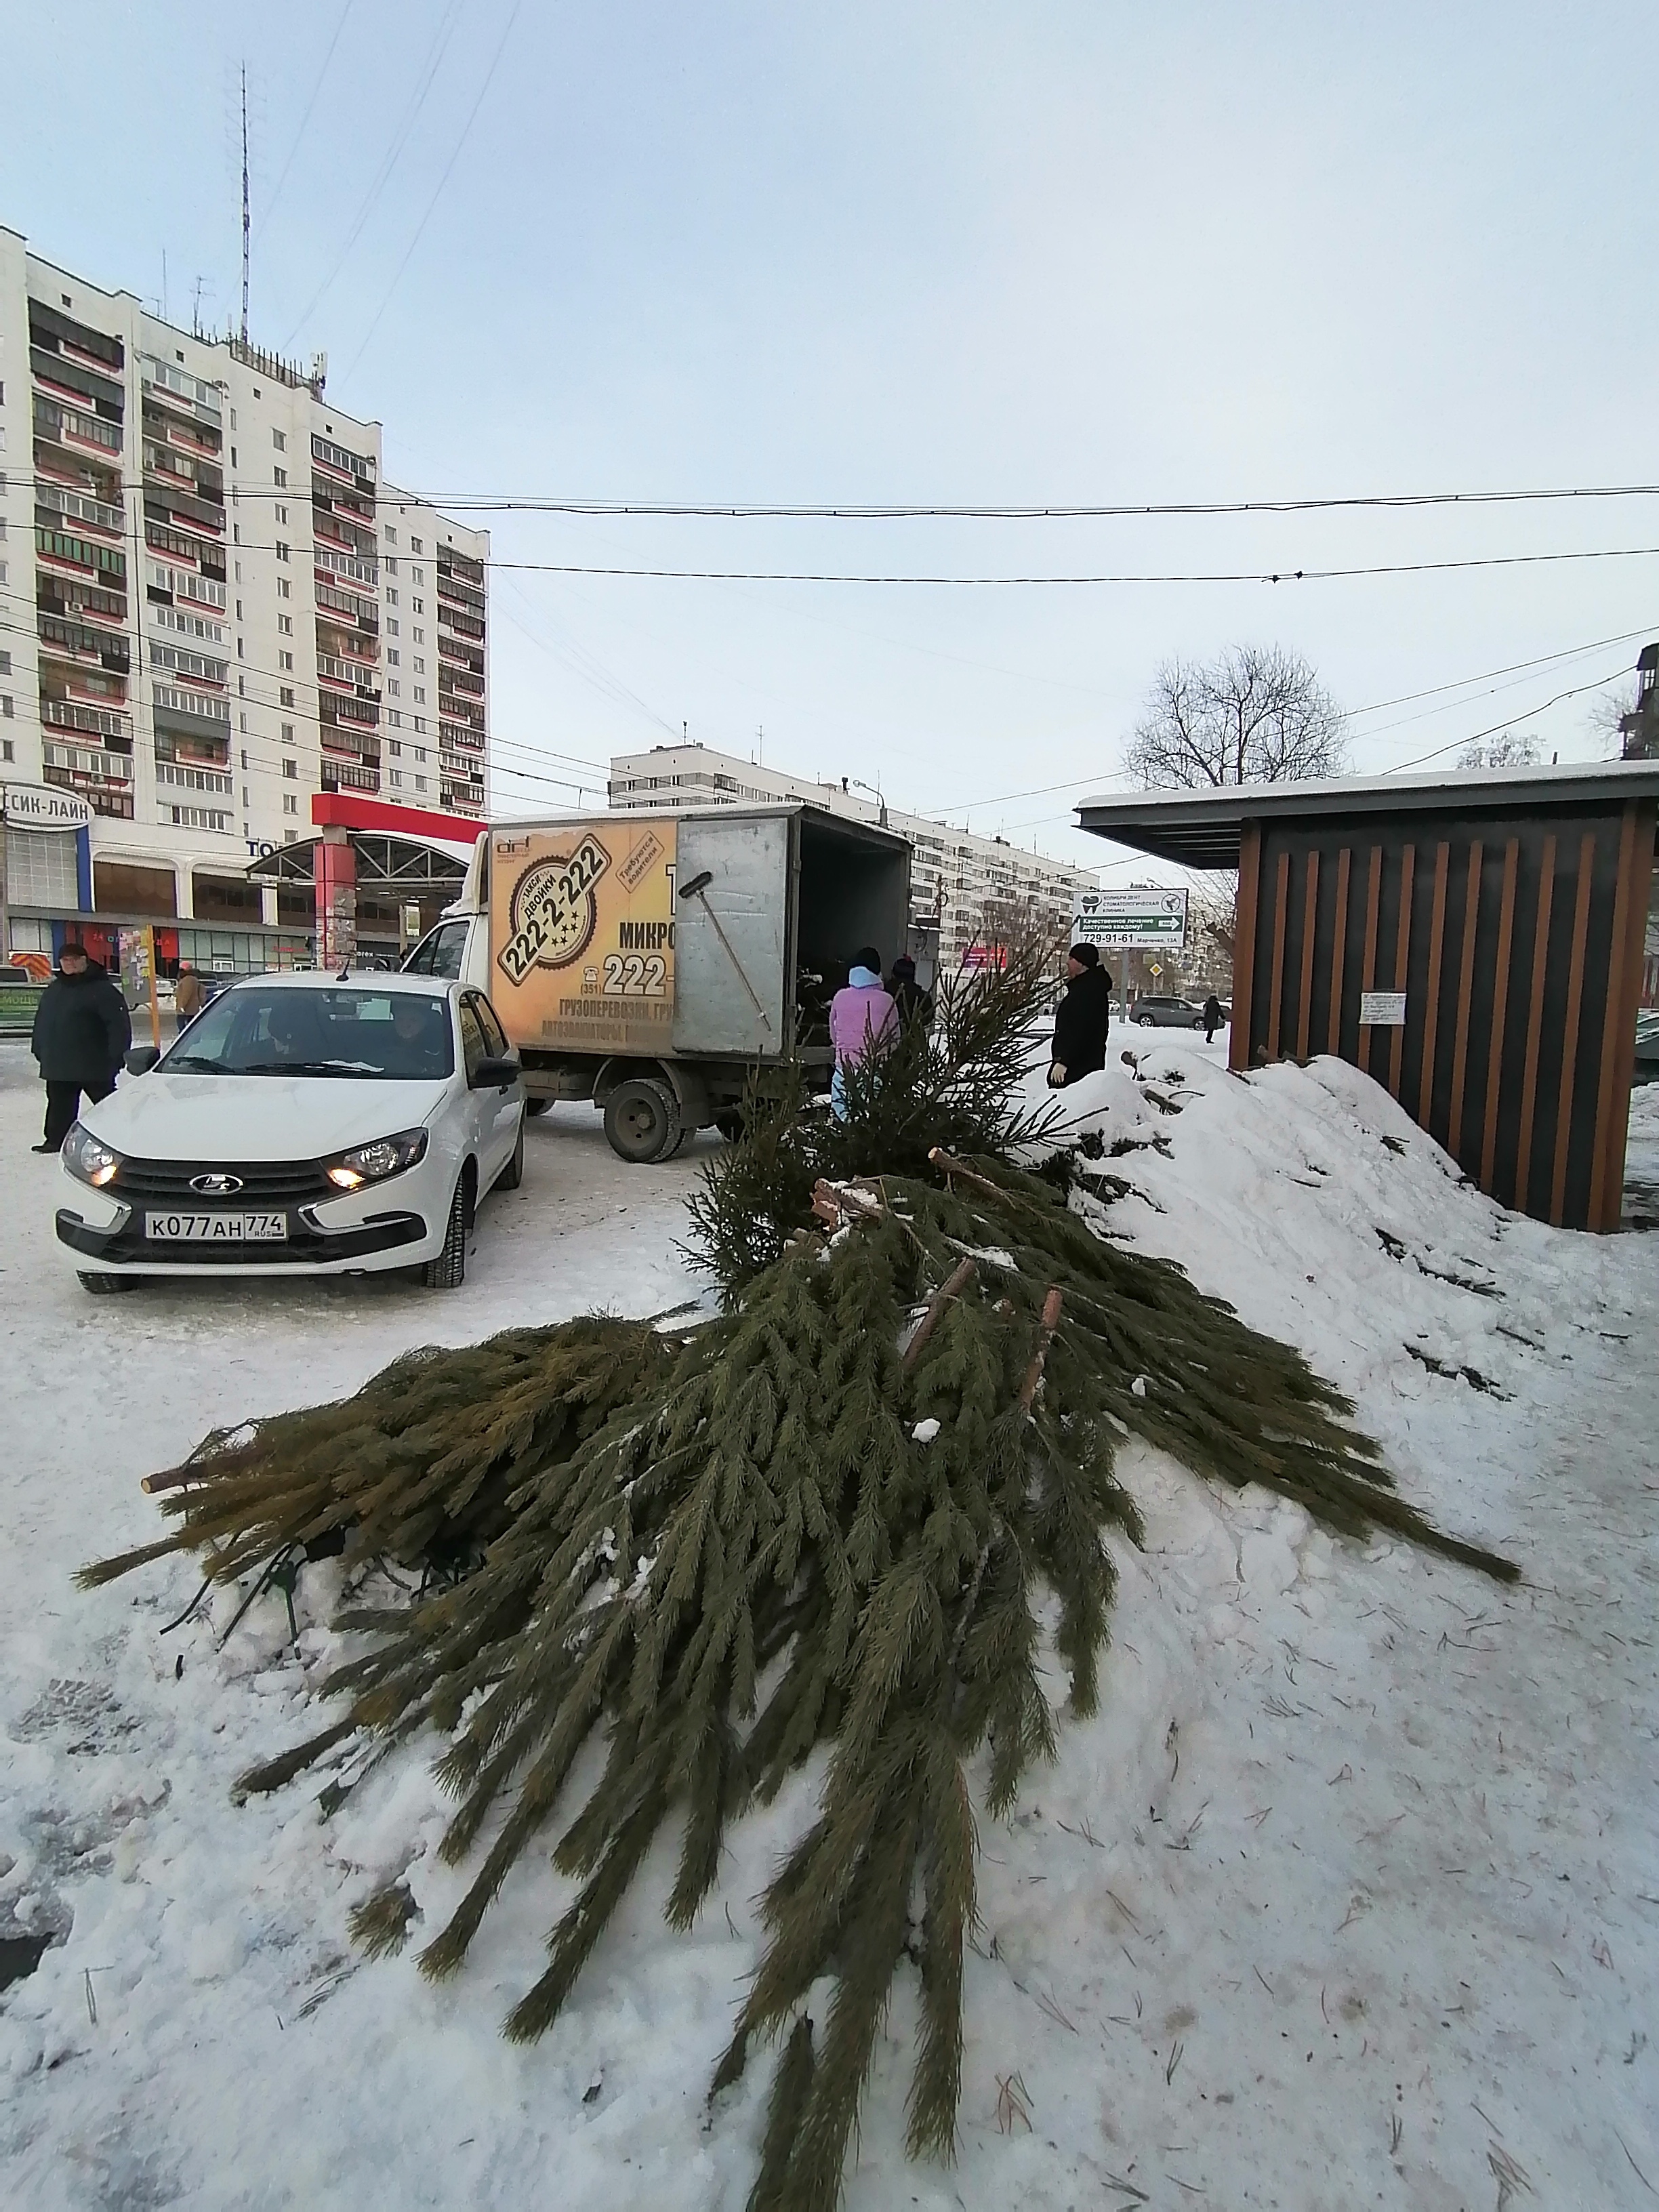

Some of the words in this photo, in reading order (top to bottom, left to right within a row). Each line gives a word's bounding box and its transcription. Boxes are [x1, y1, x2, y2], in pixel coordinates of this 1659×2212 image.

[619, 836, 654, 878] Требуются
[628, 846, 657, 884] водители
[523, 874, 541, 898] ТАКСИ
[524, 874, 556, 920] ДВОЙКИ
[506, 846, 604, 977] 222-2-222
[1084, 933, 1133, 943] 729-91-61
[580, 984, 601, 996] (351)
[152, 1216, 241, 1237] К077АН
[246, 1216, 281, 1231] 774
